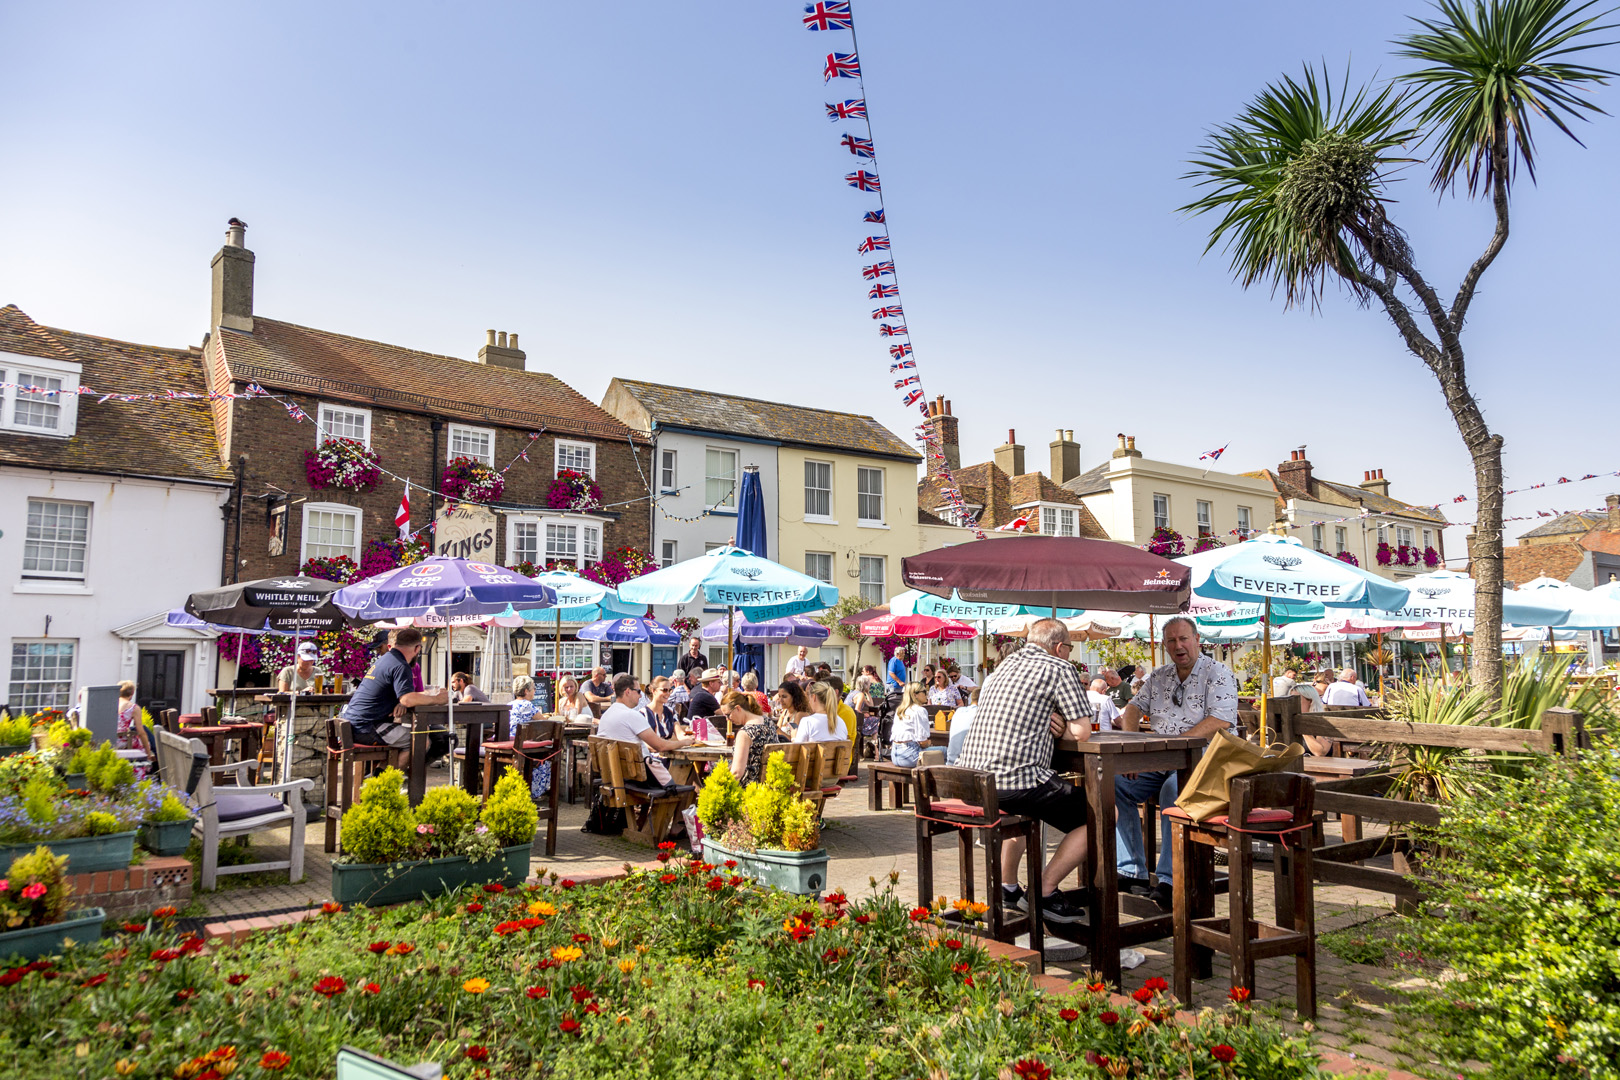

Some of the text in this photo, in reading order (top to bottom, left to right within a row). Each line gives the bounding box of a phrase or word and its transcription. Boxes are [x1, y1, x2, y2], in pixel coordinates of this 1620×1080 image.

[454, 507, 475, 520] The
[438, 528, 494, 559] KINGS
[1143, 578, 1181, 586] Heineken
[1233, 576, 1341, 596] FEVER-TREE
[255, 592, 321, 602] WHITLEY NEILL
[717, 589, 801, 602] FEVER-TREE
[933, 603, 1008, 615] FEVER-TREE
[1179, 605, 1221, 615] R-TREE
